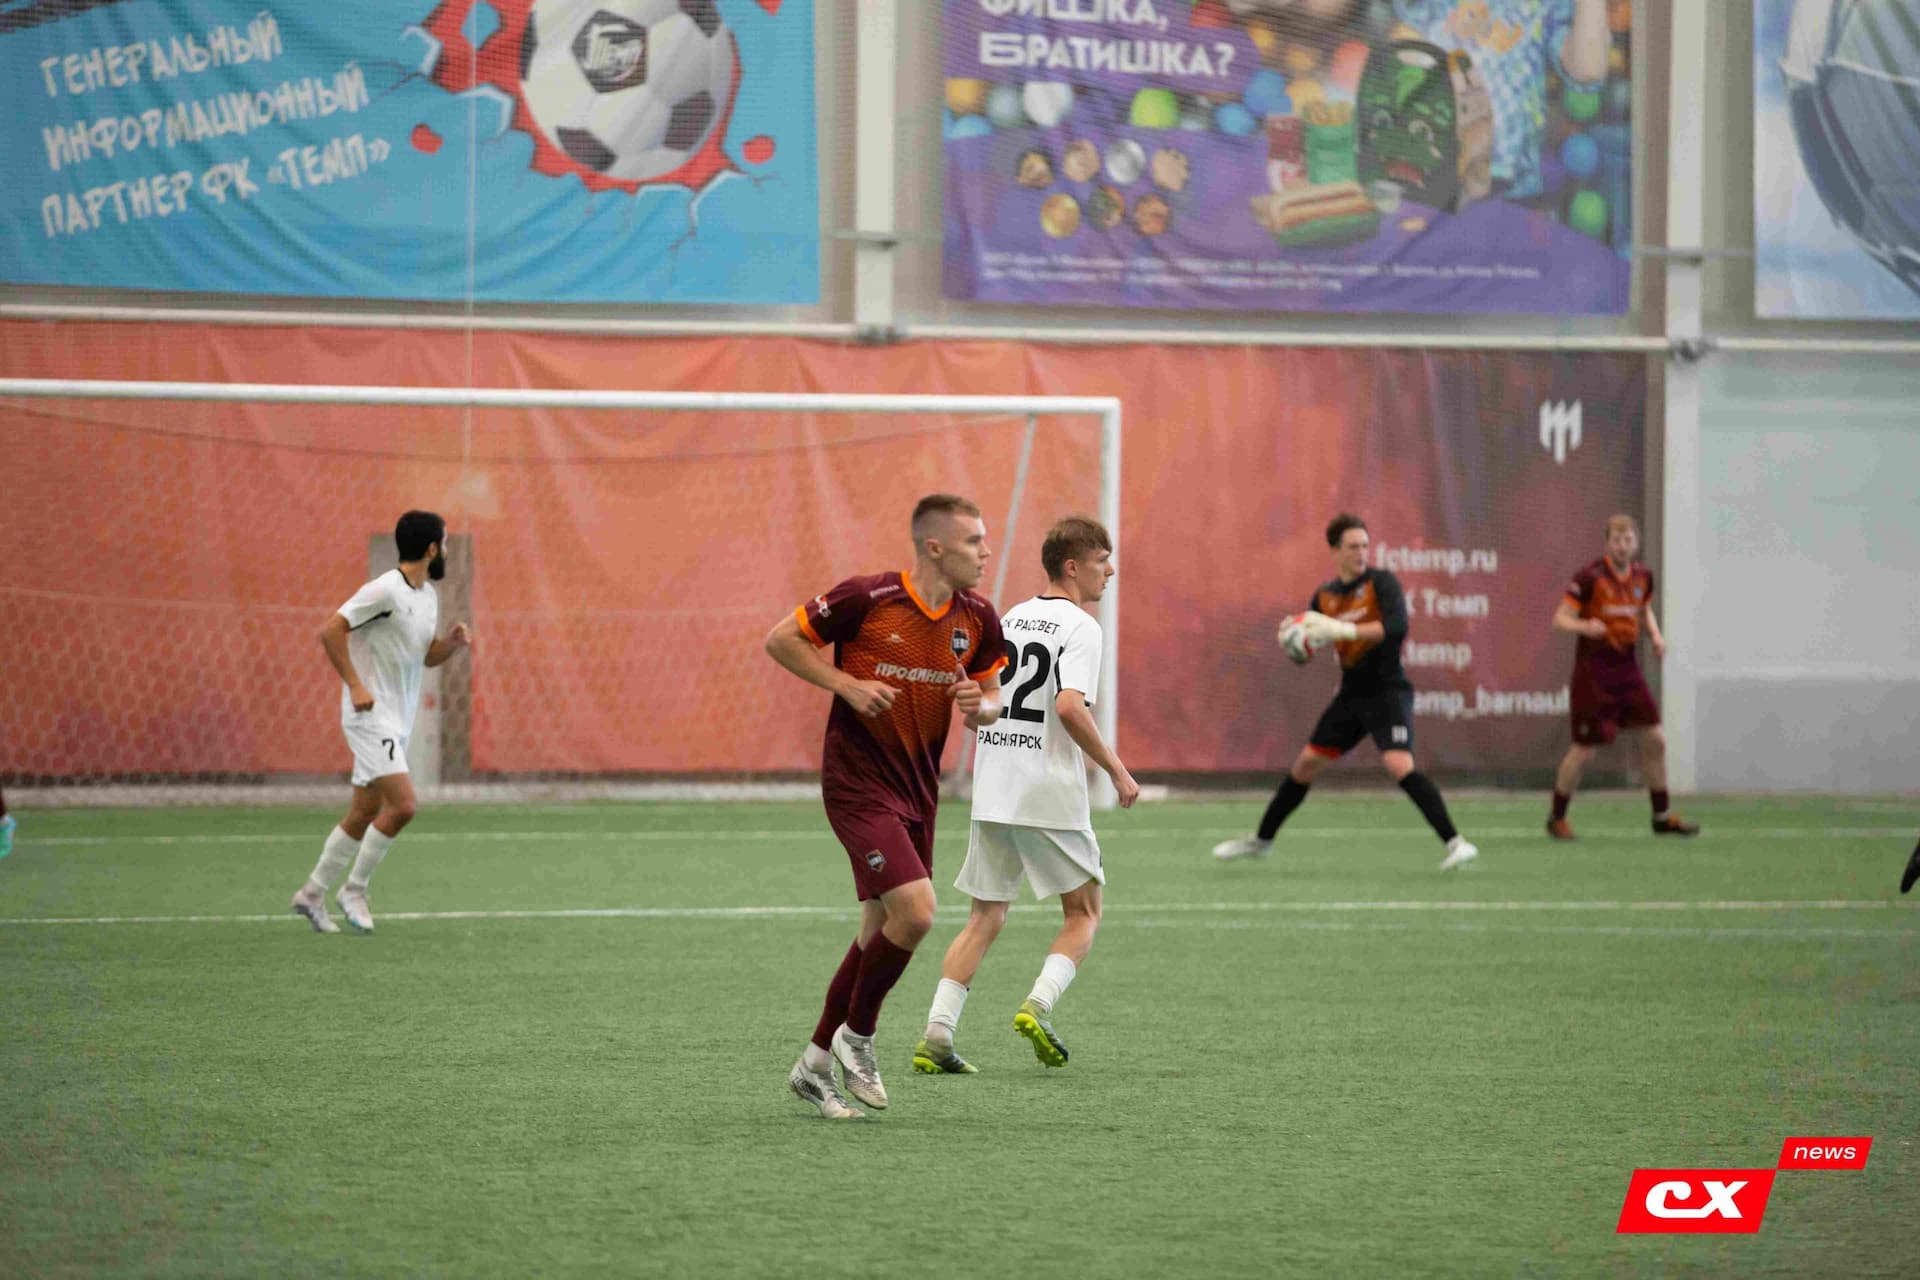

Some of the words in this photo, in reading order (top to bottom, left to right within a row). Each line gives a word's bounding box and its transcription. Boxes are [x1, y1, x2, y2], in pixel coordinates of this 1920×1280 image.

[40, 11, 283, 97] ГЕНЕРАЛЬНЫЙ
[979, 32, 1236, 77] БРАТИШКА?
[43, 61, 369, 171] ИНФОРМАЦИОННЫЙ
[42, 170, 193, 237] ПАРТНЕР
[202, 157, 259, 203] ФК
[267, 133, 391, 190] «ТЕМП»
[1376, 542, 1497, 577] fctemp.ru
[1422, 588, 1488, 617] Темп
[382, 739, 394, 760] 7
[978, 730, 1042, 750] РАСНЯРСК
